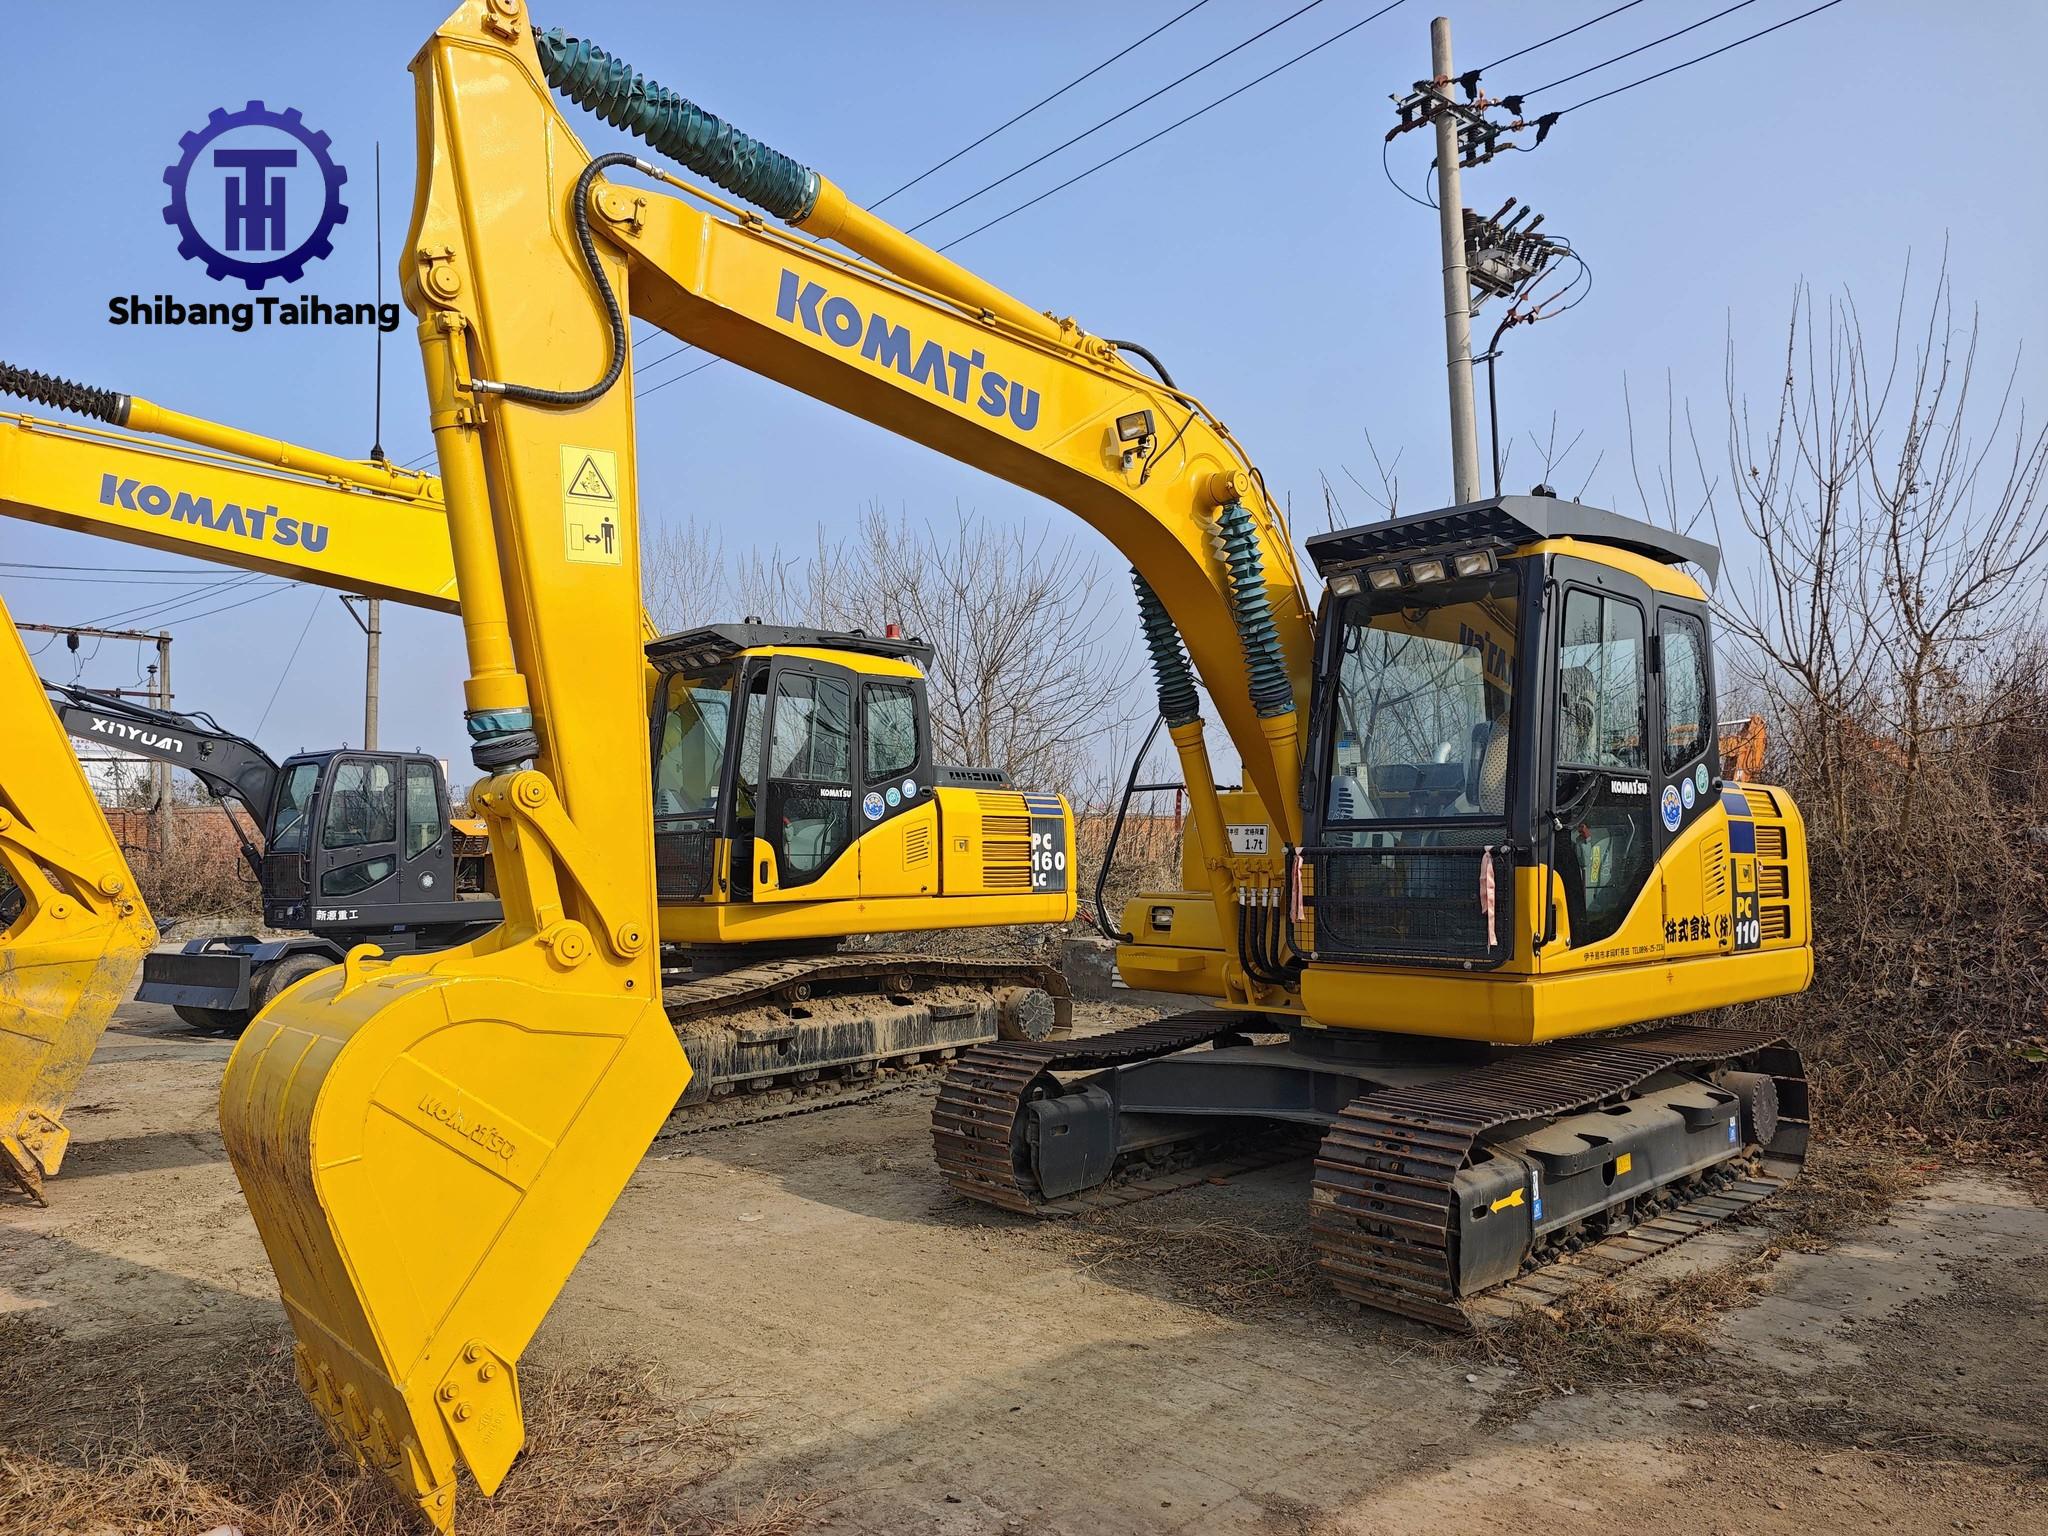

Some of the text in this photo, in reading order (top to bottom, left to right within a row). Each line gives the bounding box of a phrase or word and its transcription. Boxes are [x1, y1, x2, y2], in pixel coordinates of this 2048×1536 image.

[776, 268, 1040, 431] KOMATSU
[100, 473, 329, 552] KOMATSU
[820, 788, 852, 798] KOMATSU
[1611, 780, 1648, 795] KOMATSU
[1032, 833, 1052, 850] PC
[1245, 838, 1263, 850] 1.7t
[1032, 851, 1065, 871] 160
[1032, 873, 1047, 887] LC
[316, 909, 358, 921] 新源重工
[1736, 897, 1752, 919] PC
[1736, 919, 1759, 945] 110
